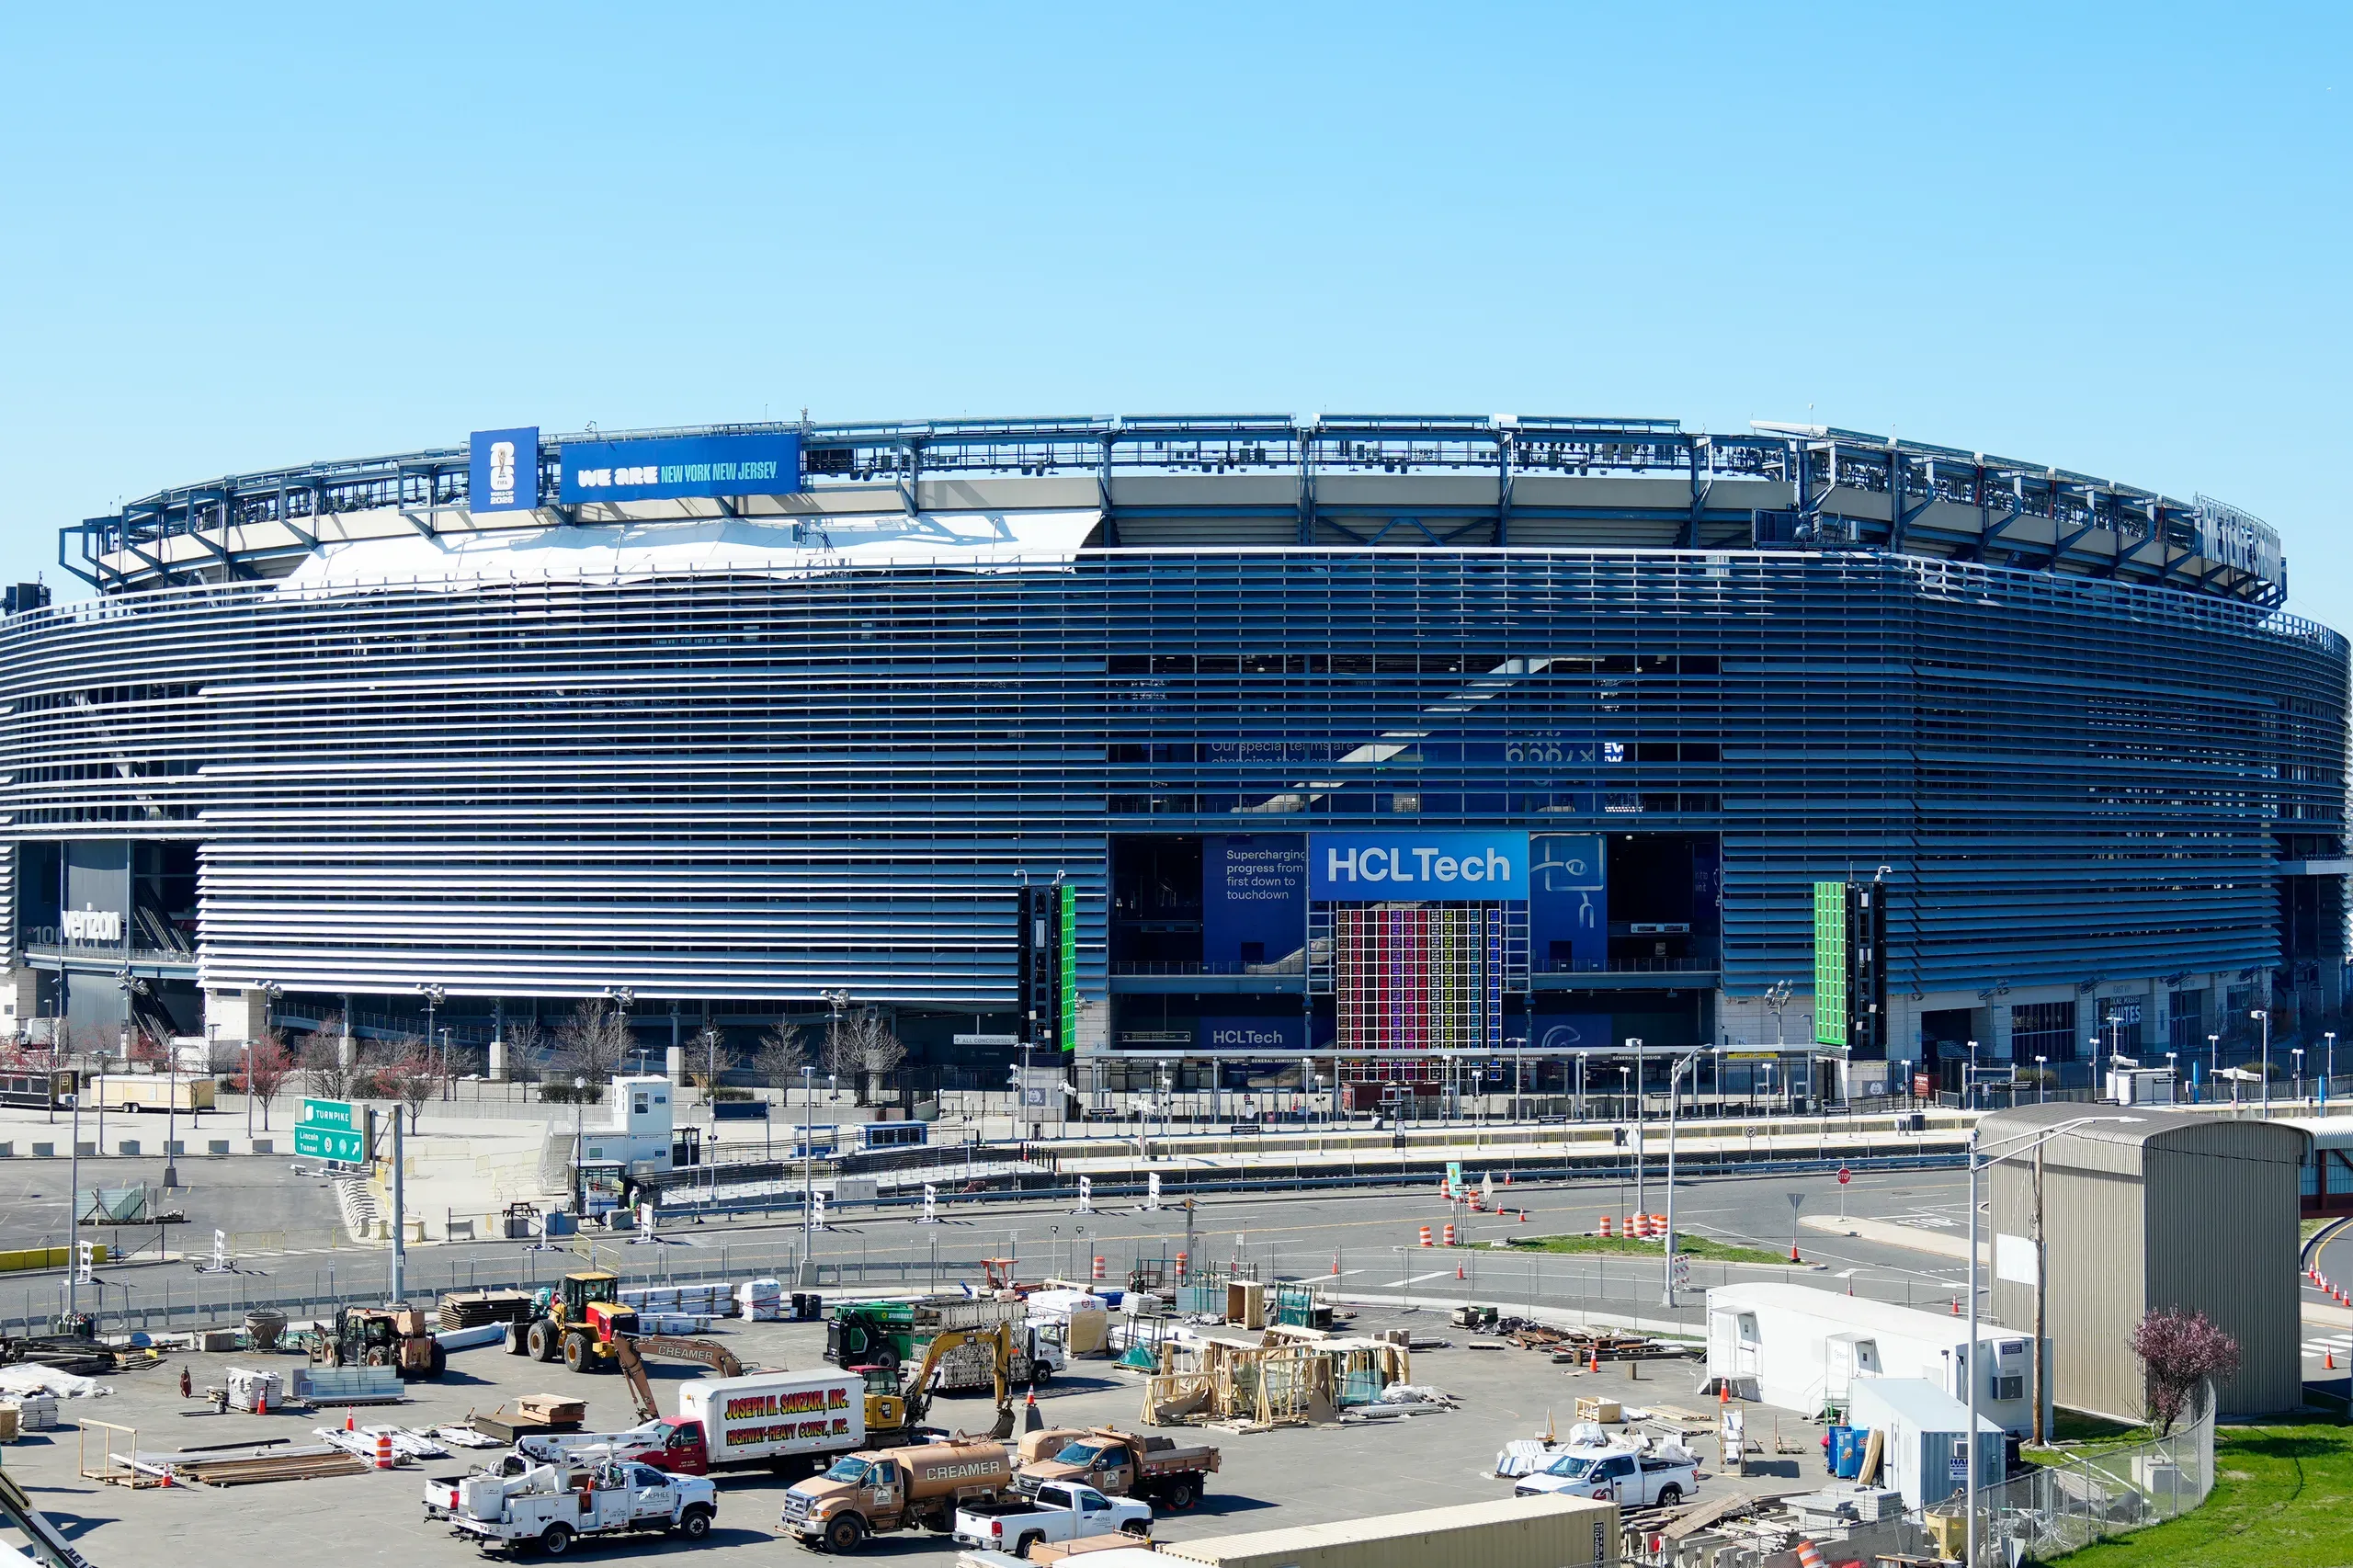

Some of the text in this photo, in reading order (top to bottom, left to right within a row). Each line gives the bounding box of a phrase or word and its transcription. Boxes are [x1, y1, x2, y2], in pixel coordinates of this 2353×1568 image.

[578, 469, 611, 487] WE
[615, 466, 657, 485] ARE
[661, 465, 684, 483] NEW
[685, 463, 710, 482] YORK
[712, 462, 736, 481] NEW
[1226, 863, 1303, 874] progress from
[1328, 847, 1510, 881] HCLTech
[1226, 876, 1296, 886] first down to
[1226, 890, 1289, 900] touchdown
[62, 903, 120, 940] verizon
[1213, 1030, 1283, 1043] HCLTech
[316, 1110, 349, 1121] TURNPIKE
[300, 1131, 319, 1142] Lincoln
[300, 1142, 318, 1153] Tunnel
[658, 1346, 713, 1360] CREAMER
[725, 1388, 850, 1420] JOSEPH M. SANZARI, INC.
[726, 1422, 797, 1447] HIGHWAY-HEAVY
[832, 1417, 850, 1435] INC.
[926, 1461, 1000, 1481] CREAMER
[66, 1548, 83, 1564] JLG
